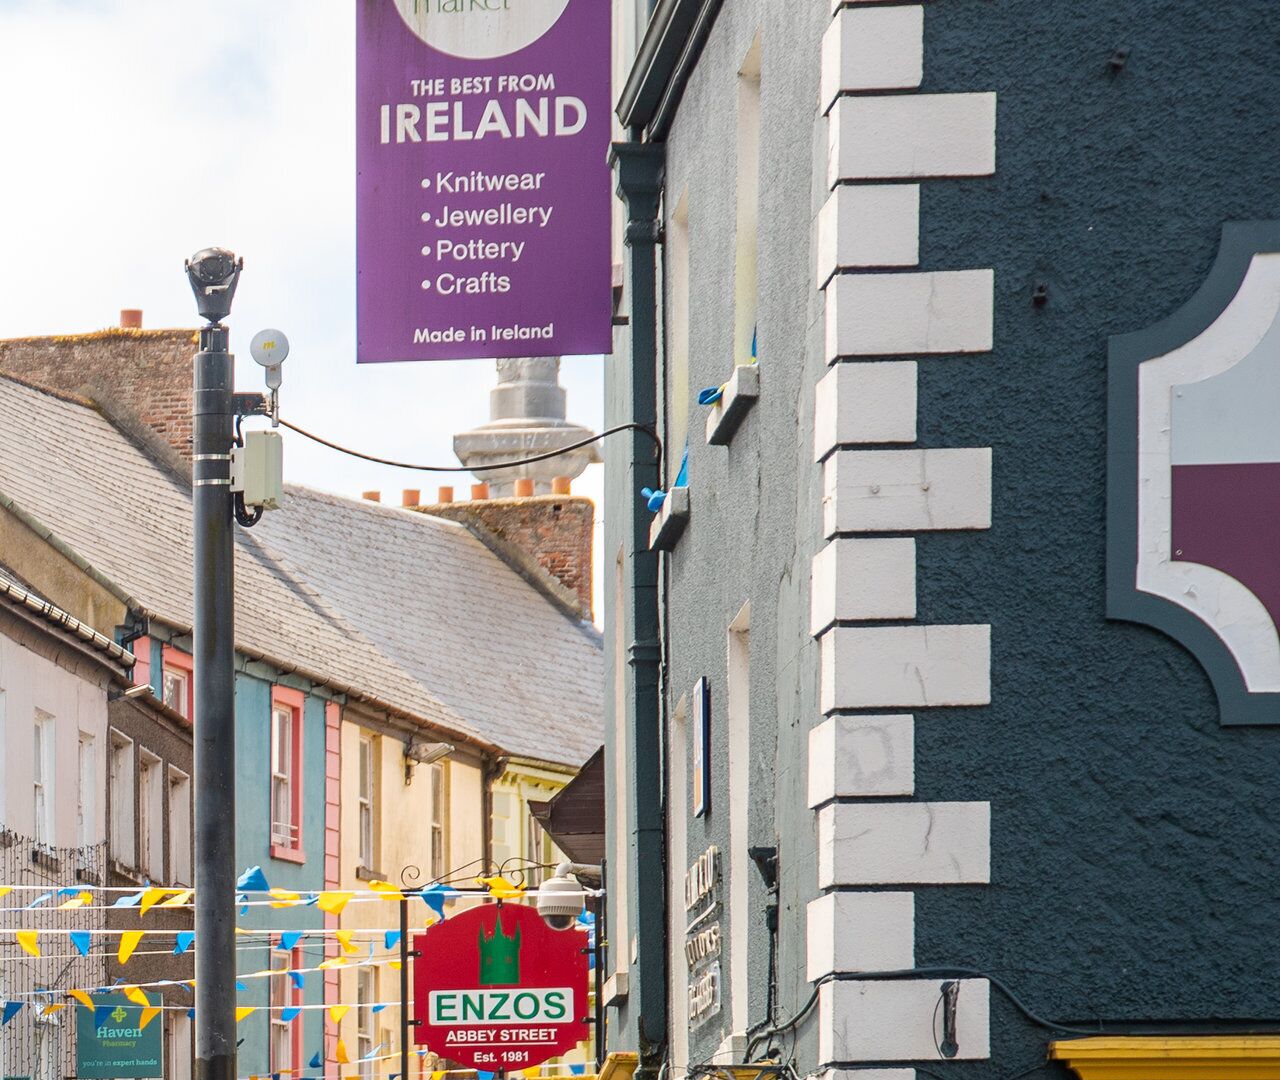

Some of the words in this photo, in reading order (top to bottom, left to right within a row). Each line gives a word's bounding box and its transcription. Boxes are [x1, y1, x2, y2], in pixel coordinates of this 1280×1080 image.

[411, 79, 444, 96] THE
[451, 76, 492, 95] BEST
[498, 73, 556, 93] FROM
[380, 96, 588, 144] IRELAND
[436, 171, 545, 193] Knitwear
[435, 203, 553, 228] Jewellery
[436, 239, 525, 262] Pottery
[436, 271, 511, 295] Crafts
[413, 327, 466, 343] Made
[471, 326, 486, 341] in
[492, 323, 554, 339] Ireland
[436, 992, 566, 1021] ENZOS
[96, 1026, 143, 1039] Haven
[446, 1030, 496, 1042] ABBEY
[500, 1028, 557, 1041] STREET
[136, 1058, 158, 1066] hands
[473, 1052, 498, 1063] Est.
[501, 1051, 529, 1062] 1981
